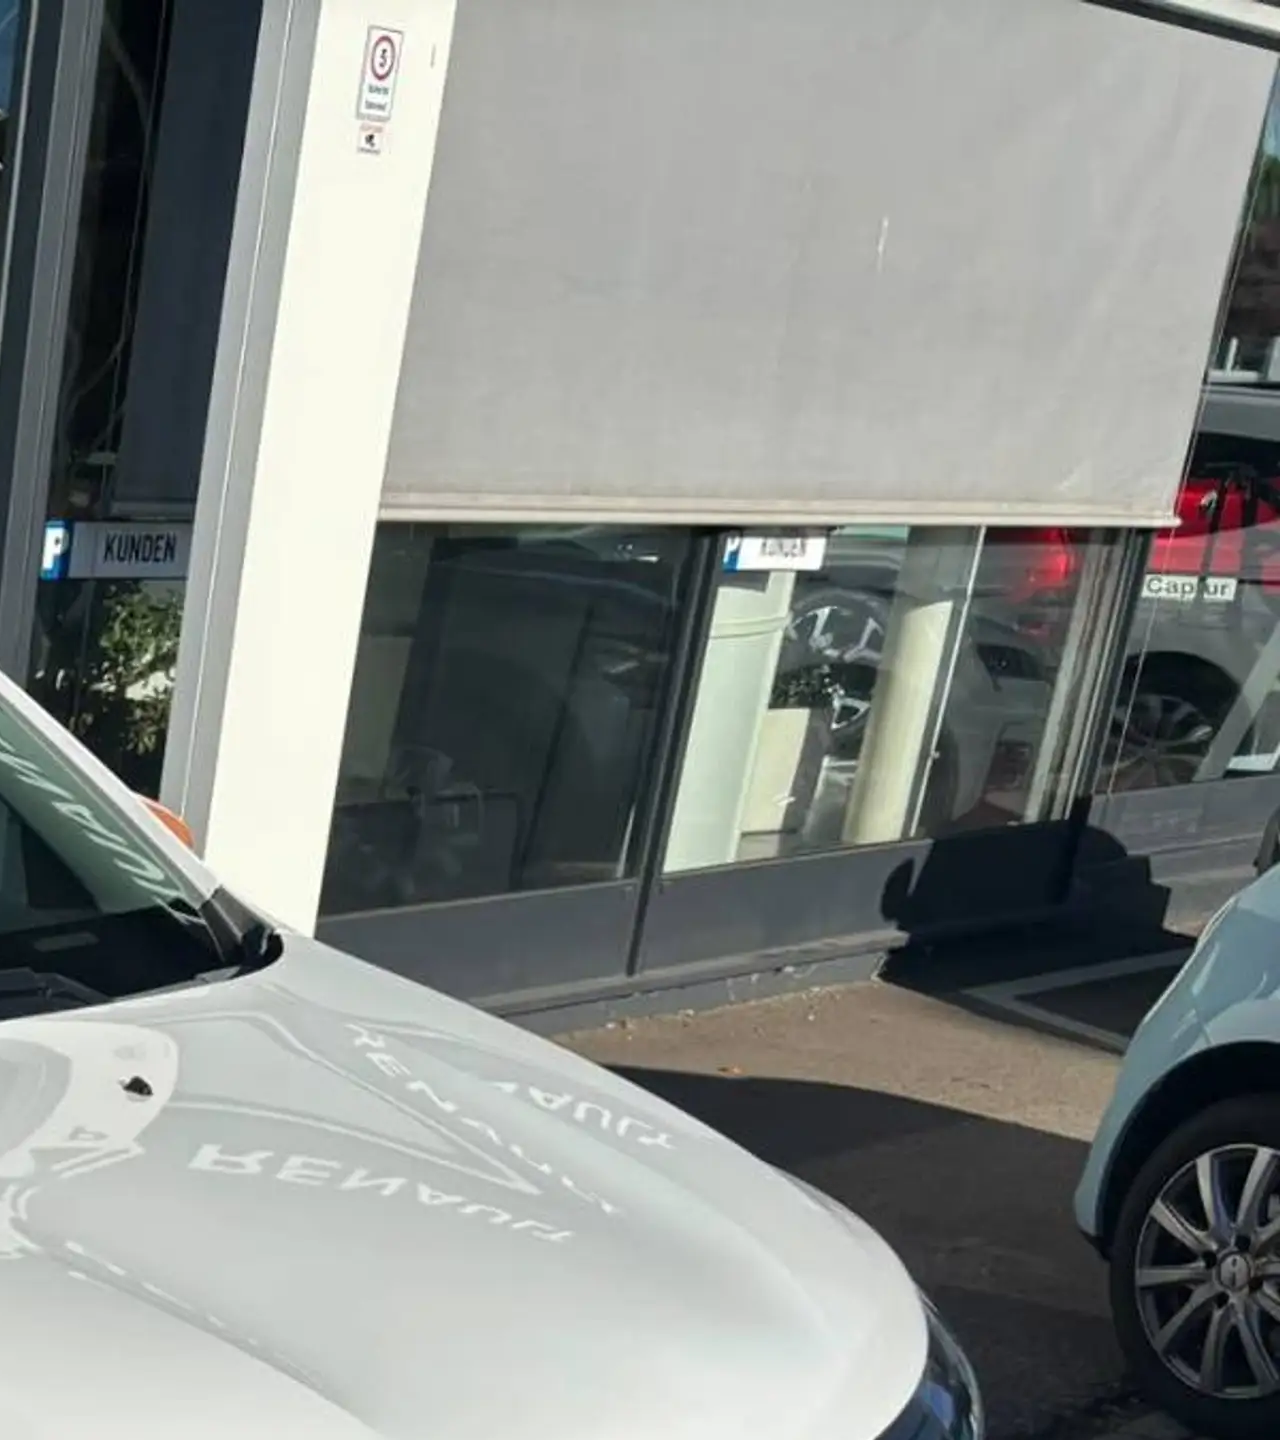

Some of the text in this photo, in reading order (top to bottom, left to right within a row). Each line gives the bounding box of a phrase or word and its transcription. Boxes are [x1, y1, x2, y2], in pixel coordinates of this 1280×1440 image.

[42, 527, 177, 569] P KUNDEN
[1147, 577, 1230, 599] Capur
